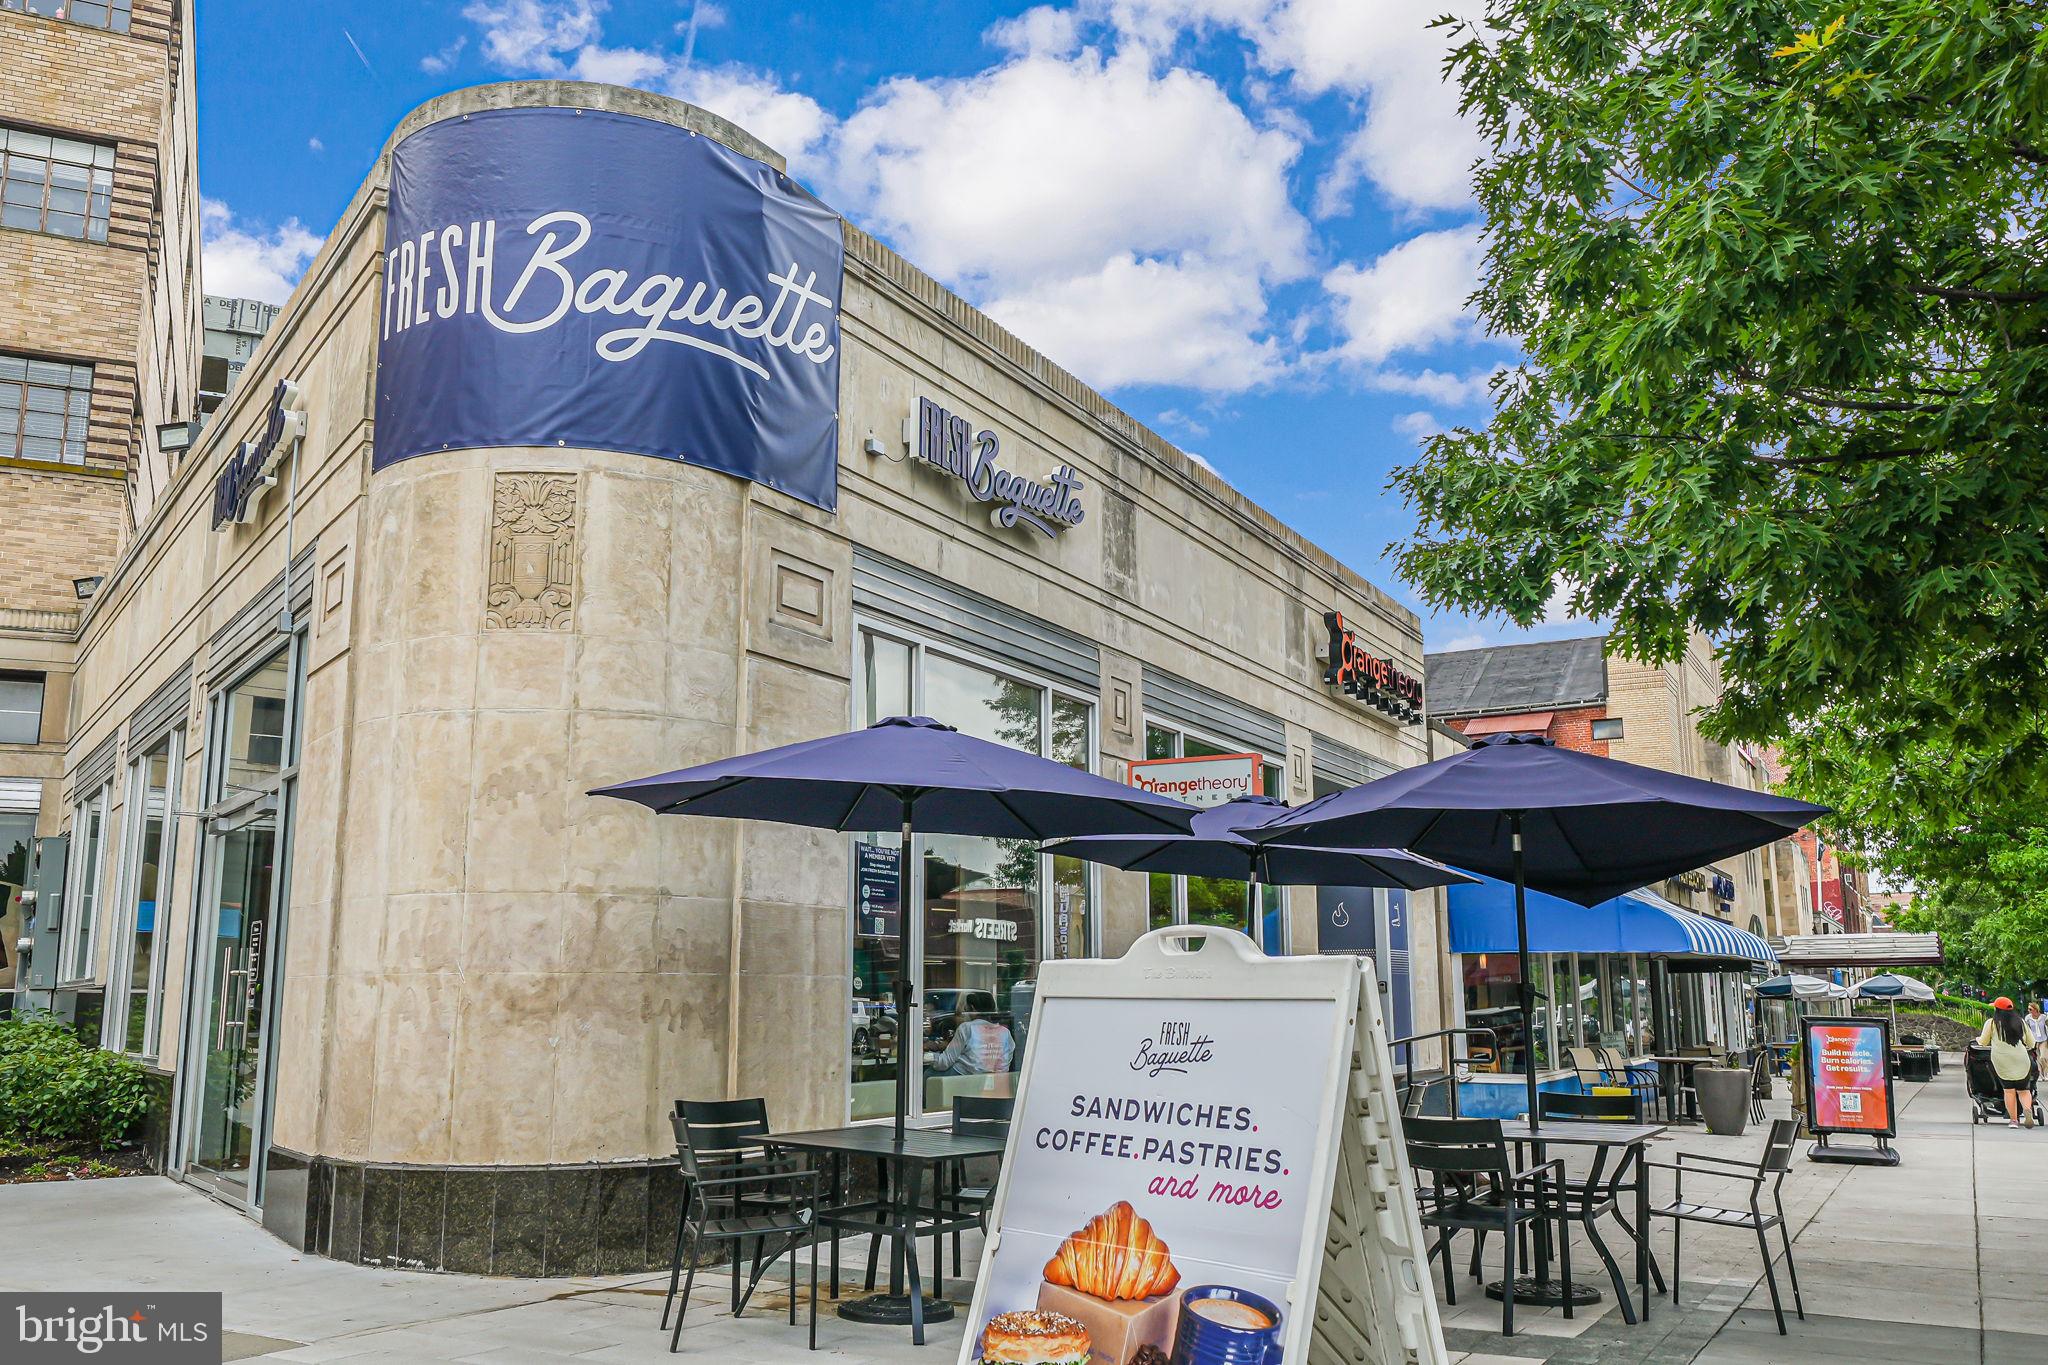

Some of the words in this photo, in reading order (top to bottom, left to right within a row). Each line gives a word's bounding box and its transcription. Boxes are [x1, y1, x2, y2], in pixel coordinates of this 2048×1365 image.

[384, 220, 495, 341] FRESH
[483, 211, 835, 381] Baguette
[919, 396, 973, 479] FRESH
[967, 429, 1086, 538] Baguette
[1170, 792, 1248, 802] TNES
[1159, 1022, 1191, 1046] FRESH
[1130, 1034, 1214, 1078] Baguette
[1826, 1064, 1841, 1072] Get
[1841, 1065, 1871, 1073] results.
[1070, 1095, 1258, 1132] SANDWICHES.
[1148, 1173, 1199, 1200] and
[1207, 1180, 1283, 1210] more
